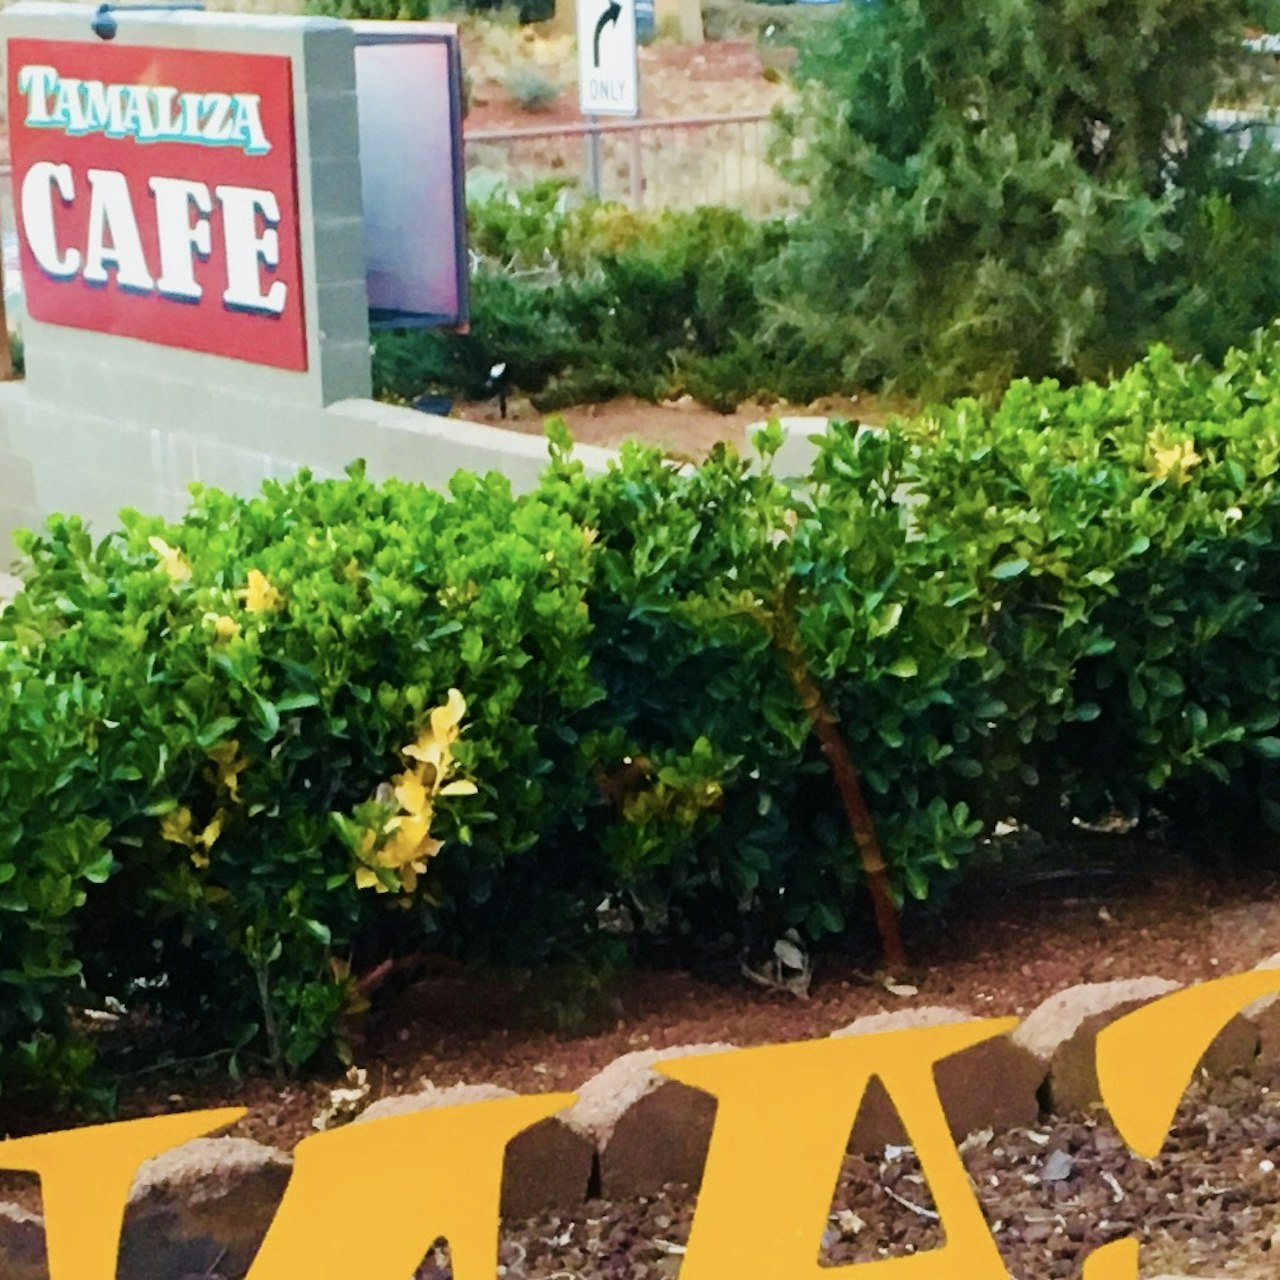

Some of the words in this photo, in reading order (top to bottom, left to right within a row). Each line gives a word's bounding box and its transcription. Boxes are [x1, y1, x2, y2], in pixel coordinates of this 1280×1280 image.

[18, 64, 271, 154] TAMALIZA
[589, 79, 626, 101] ONLY
[21, 161, 287, 319] CAFE
